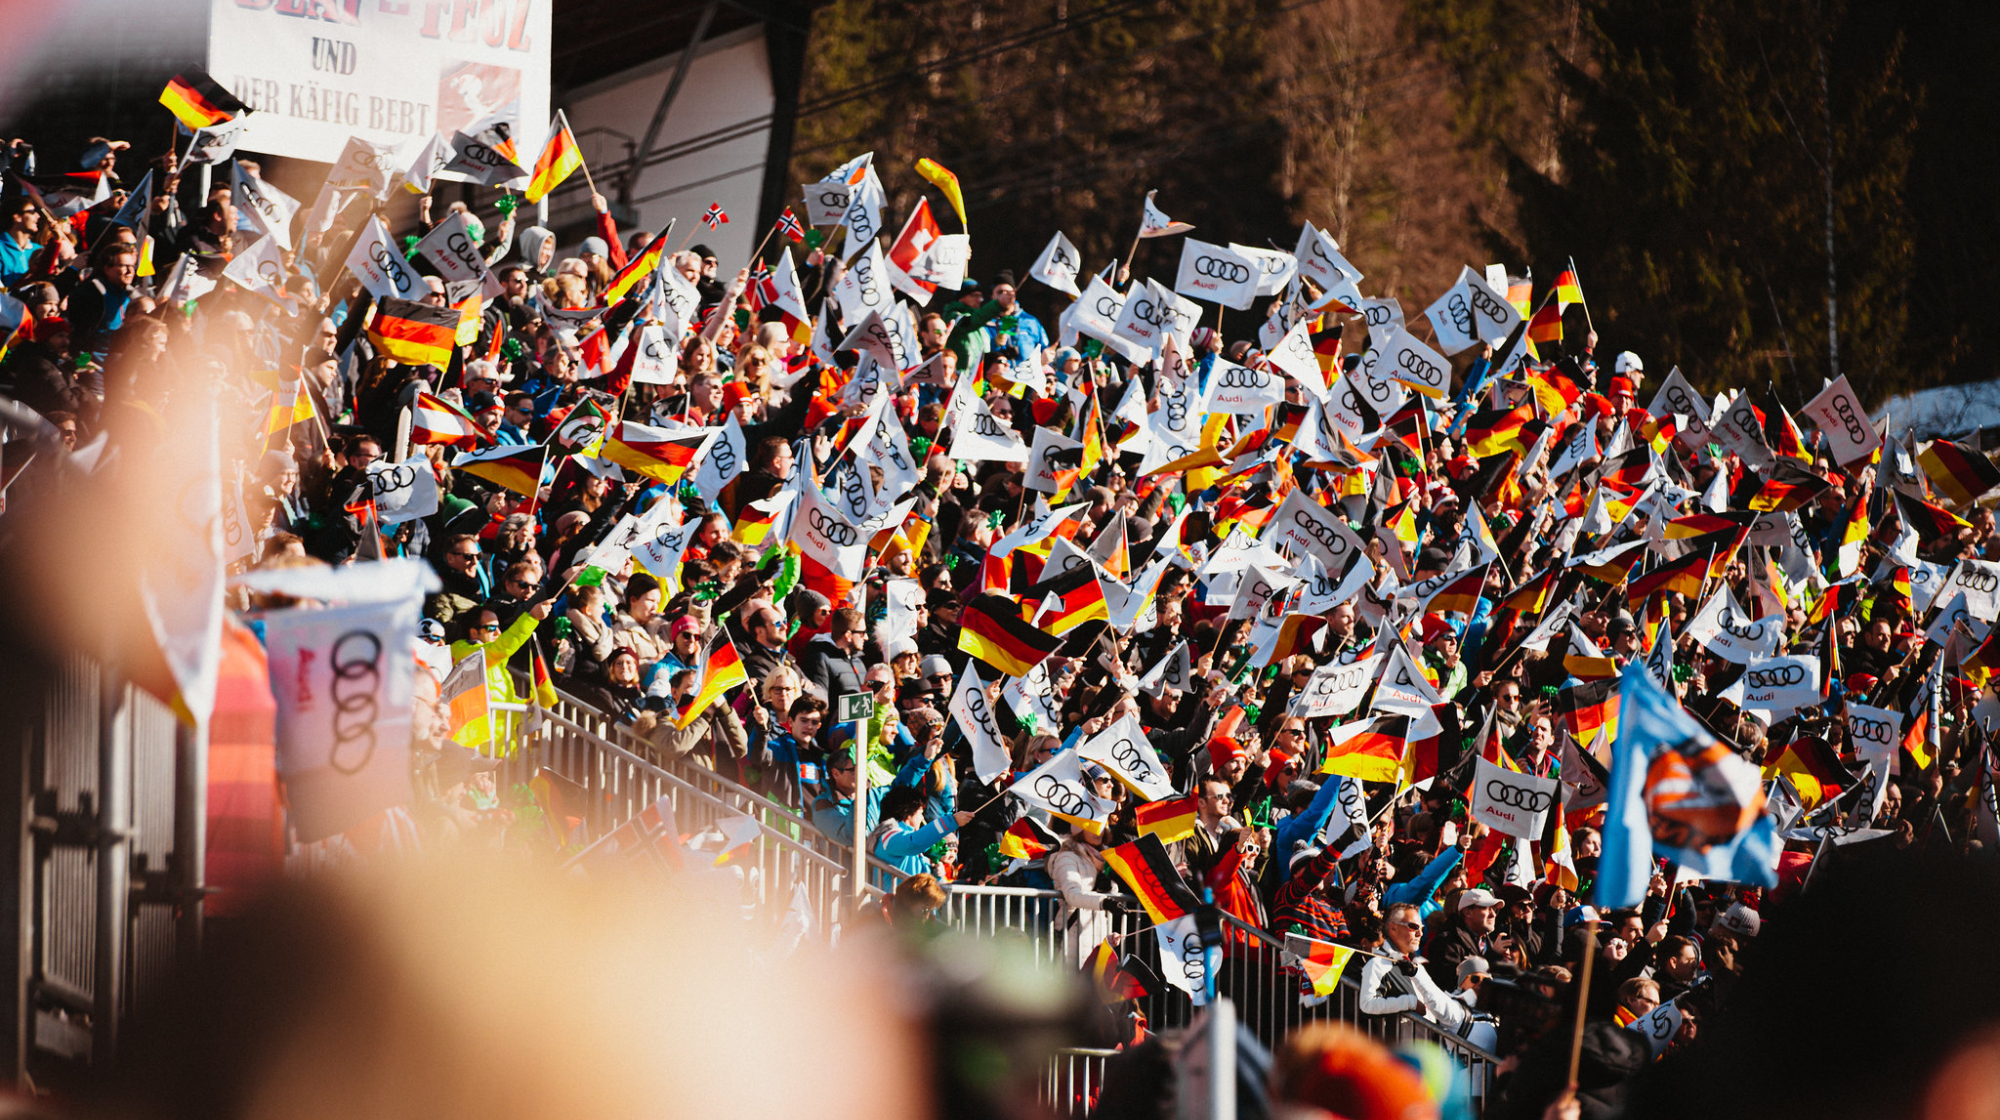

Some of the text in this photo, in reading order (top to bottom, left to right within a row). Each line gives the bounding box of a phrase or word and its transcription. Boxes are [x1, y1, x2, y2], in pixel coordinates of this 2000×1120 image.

[312, 36, 357, 76] UND
[233, 75, 431, 137] DER KÄFIG BEBT
[435, 249, 458, 270] Audi
[1307, 258, 1328, 274] Audi
[361, 261, 381, 283] Audi
[1192, 278, 1218, 291] Audi
[1127, 322, 1152, 338] Audi
[1217, 394, 1243, 403] Audi
[1333, 412, 1359, 430] Audi
[1820, 407, 1839, 428] Audi
[1722, 422, 1743, 442] Audi
[375, 500, 388, 512] di
[805, 530, 826, 551] Audi
[1286, 528, 1311, 548] Audi
[1707, 629, 1732, 648] Audi
[1392, 689, 1423, 704] Audi
[1746, 692, 1774, 702] Audi
[1485, 805, 1515, 822] Audi
